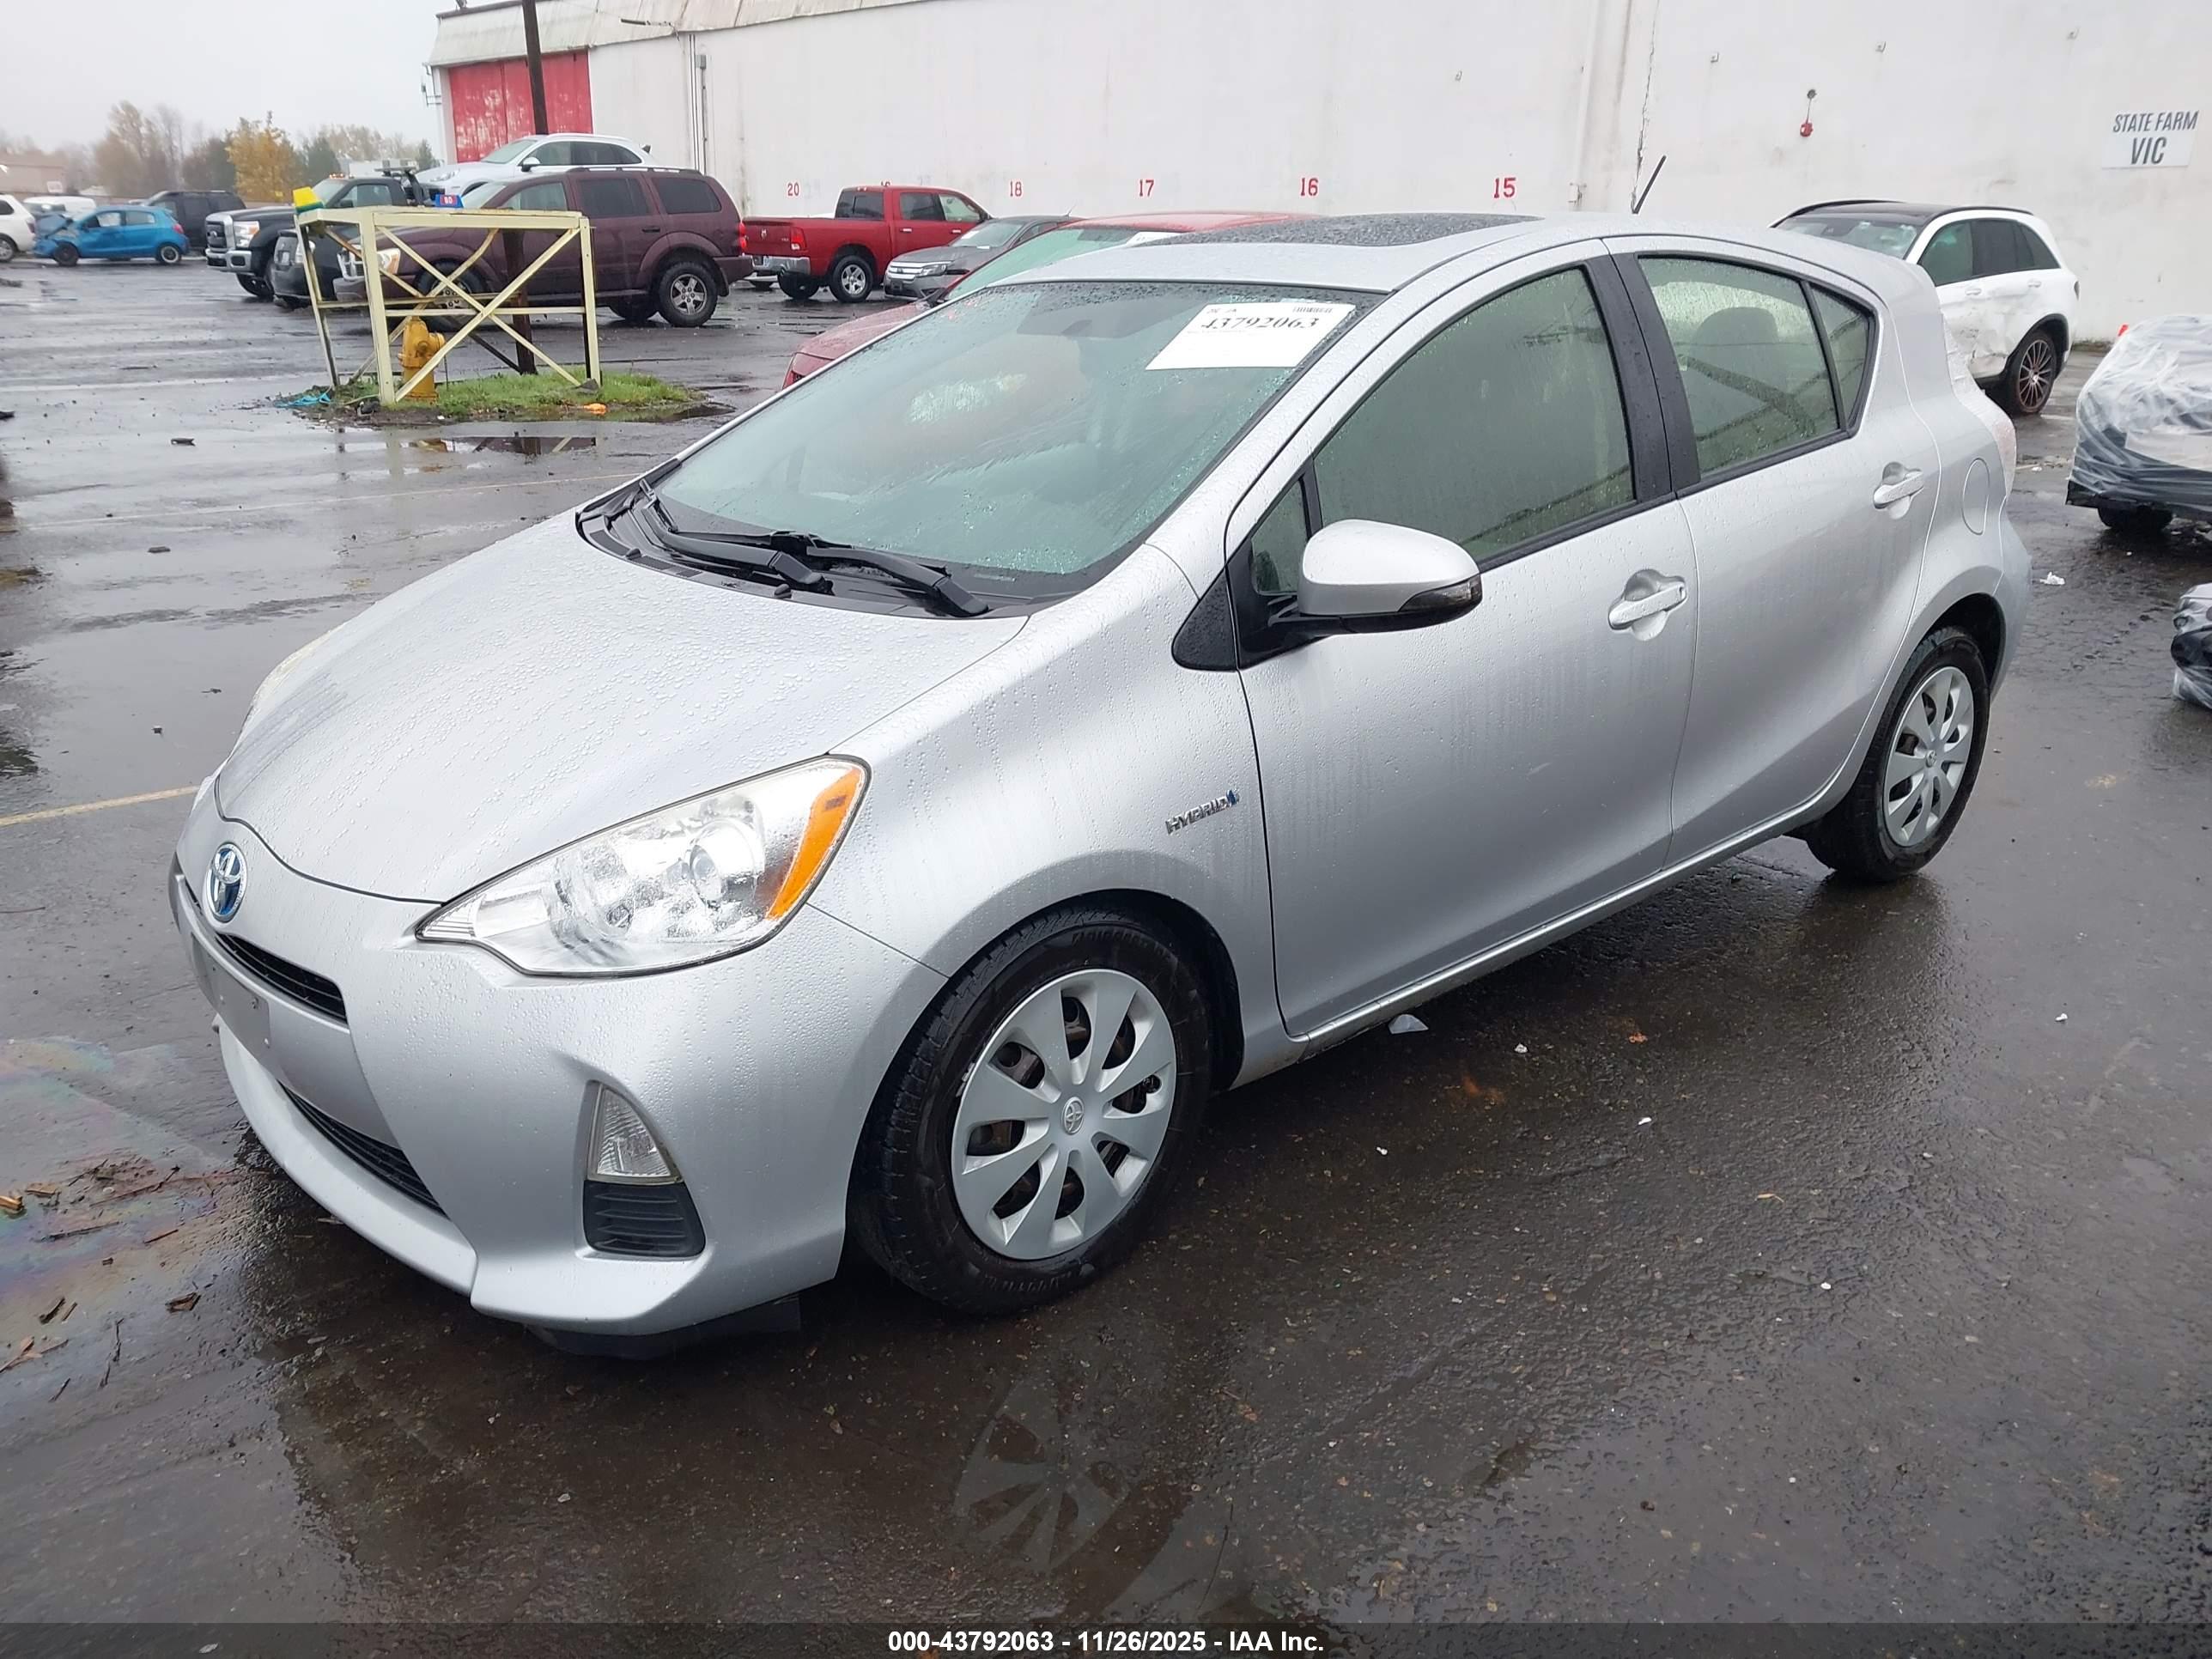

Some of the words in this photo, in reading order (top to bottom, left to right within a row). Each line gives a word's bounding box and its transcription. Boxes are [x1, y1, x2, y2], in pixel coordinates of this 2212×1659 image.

[2112, 112, 2154, 132] STATE
[2154, 110, 2199, 131] FARM
[2131, 137, 2166, 164] VIC
[787, 182, 799, 196] 20
[1010, 180, 1023, 197] 18
[1139, 179, 1154, 197] 17
[1300, 178, 1318, 196] 16
[1493, 177, 1516, 198] 15
[1201, 317, 1320, 329] 43792063
[1165, 797, 1231, 834] HYBRID
